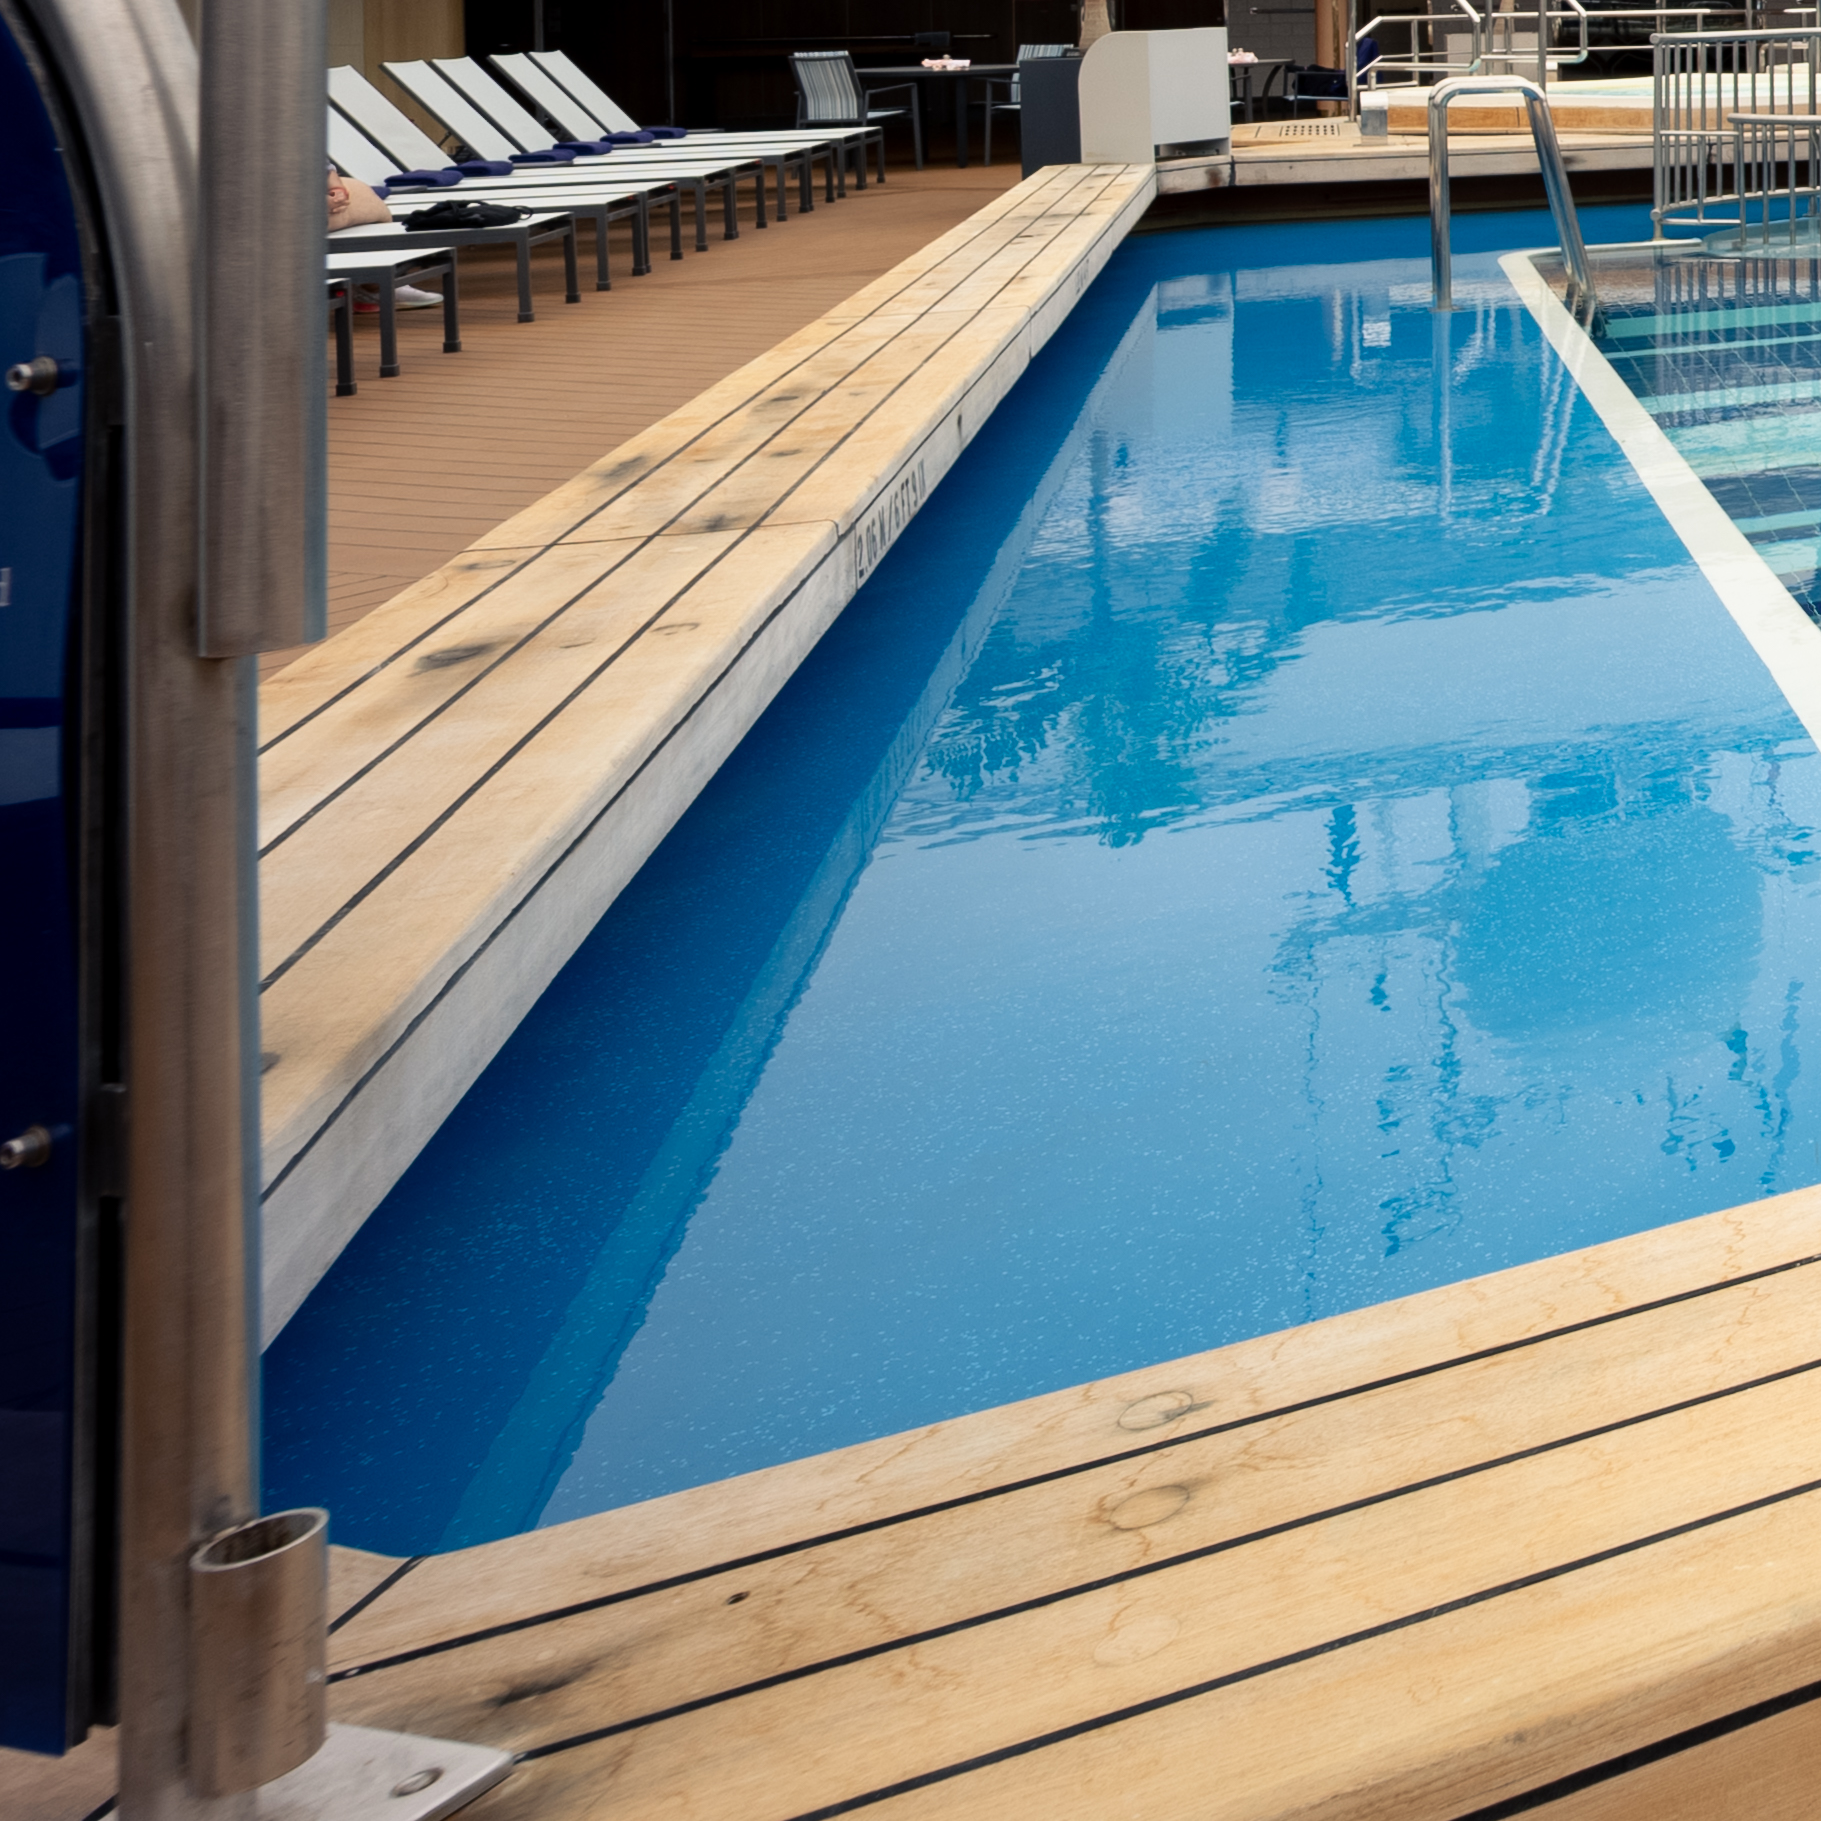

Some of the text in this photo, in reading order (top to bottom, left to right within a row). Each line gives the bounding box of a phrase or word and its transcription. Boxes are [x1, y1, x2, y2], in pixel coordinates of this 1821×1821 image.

[857, 517, 878, 580] 2.06
[900, 477, 912, 525] FT
[911, 470, 919, 509] 9
